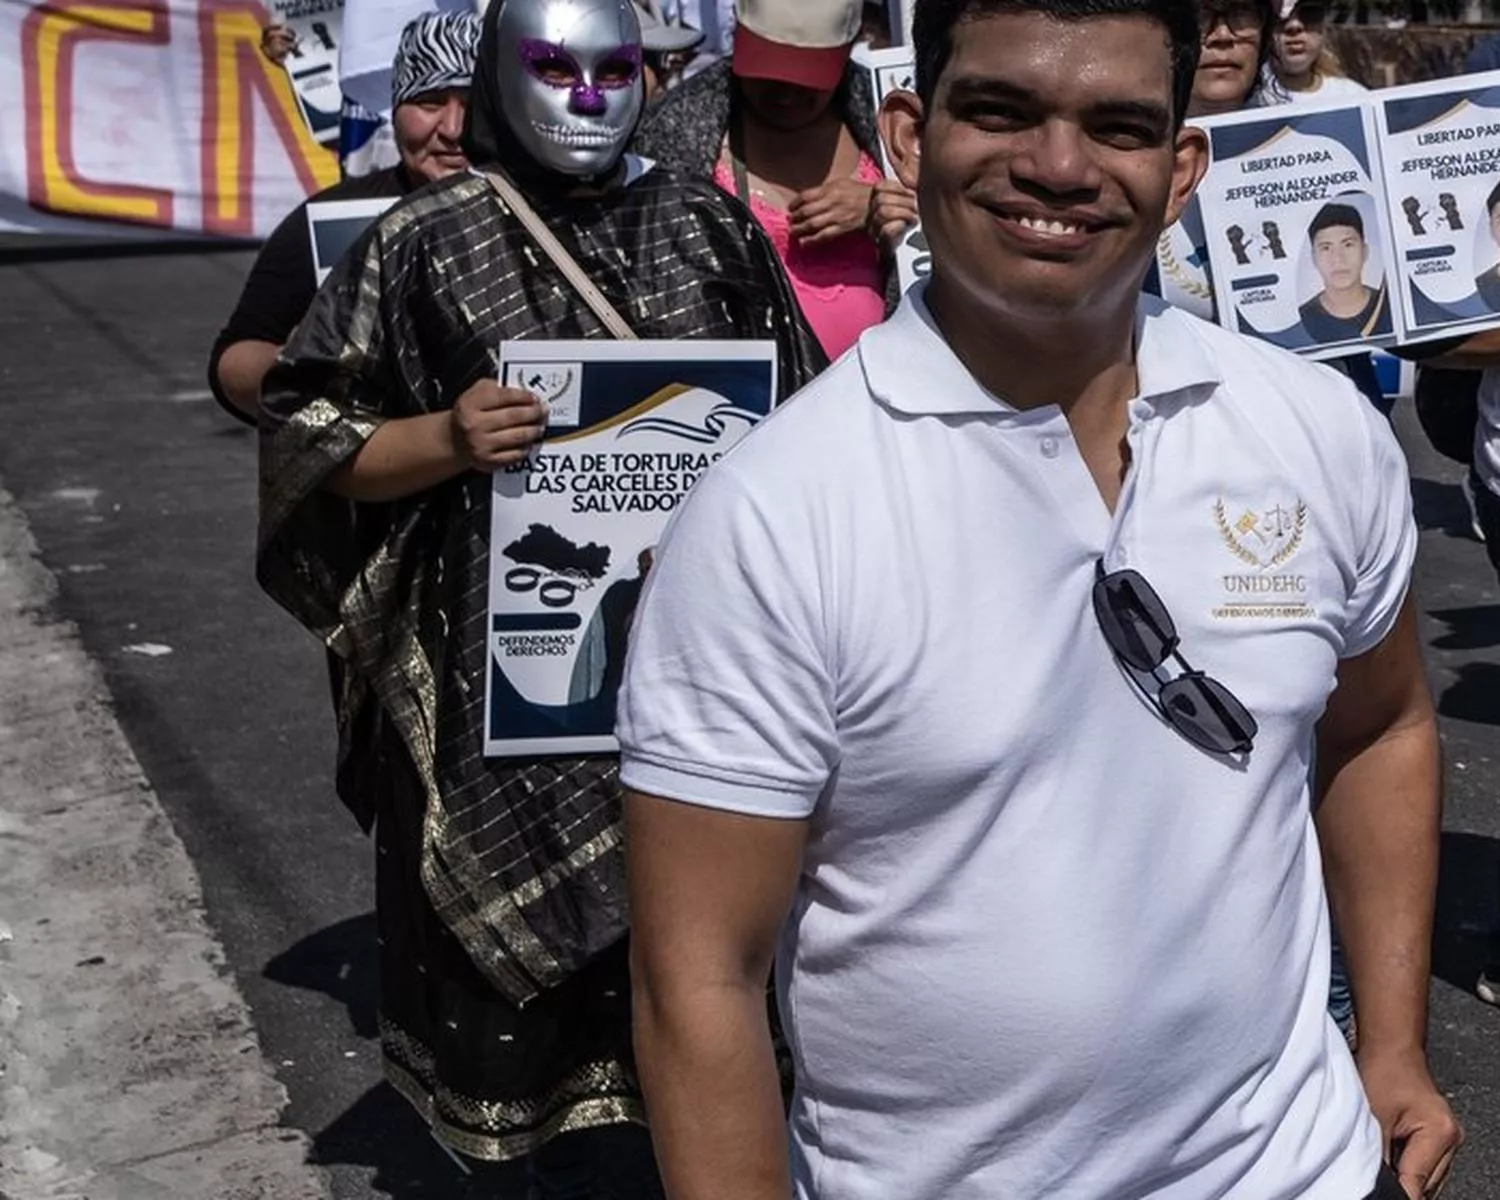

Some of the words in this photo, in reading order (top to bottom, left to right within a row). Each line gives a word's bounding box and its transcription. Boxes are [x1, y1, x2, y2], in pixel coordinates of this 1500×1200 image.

[1417, 128, 1475, 146] LIBERTAD
[1240, 155, 1296, 174] LIBERTAD
[1297, 150, 1333, 165] PARA
[1401, 154, 1461, 172] JEFERSON
[1225, 181, 1283, 201] JEFERSON
[1286, 171, 1359, 191] ALEXANDER
[581, 454, 607, 473] DE
[525, 474, 566, 493] LAS
[571, 473, 678, 492] CARCELES
[683, 472, 701, 491] D
[1222, 574, 1306, 593] UNIDEHC
[499, 634, 575, 647] DEFENDEMOS
[505, 644, 568, 657] DERECHOS
